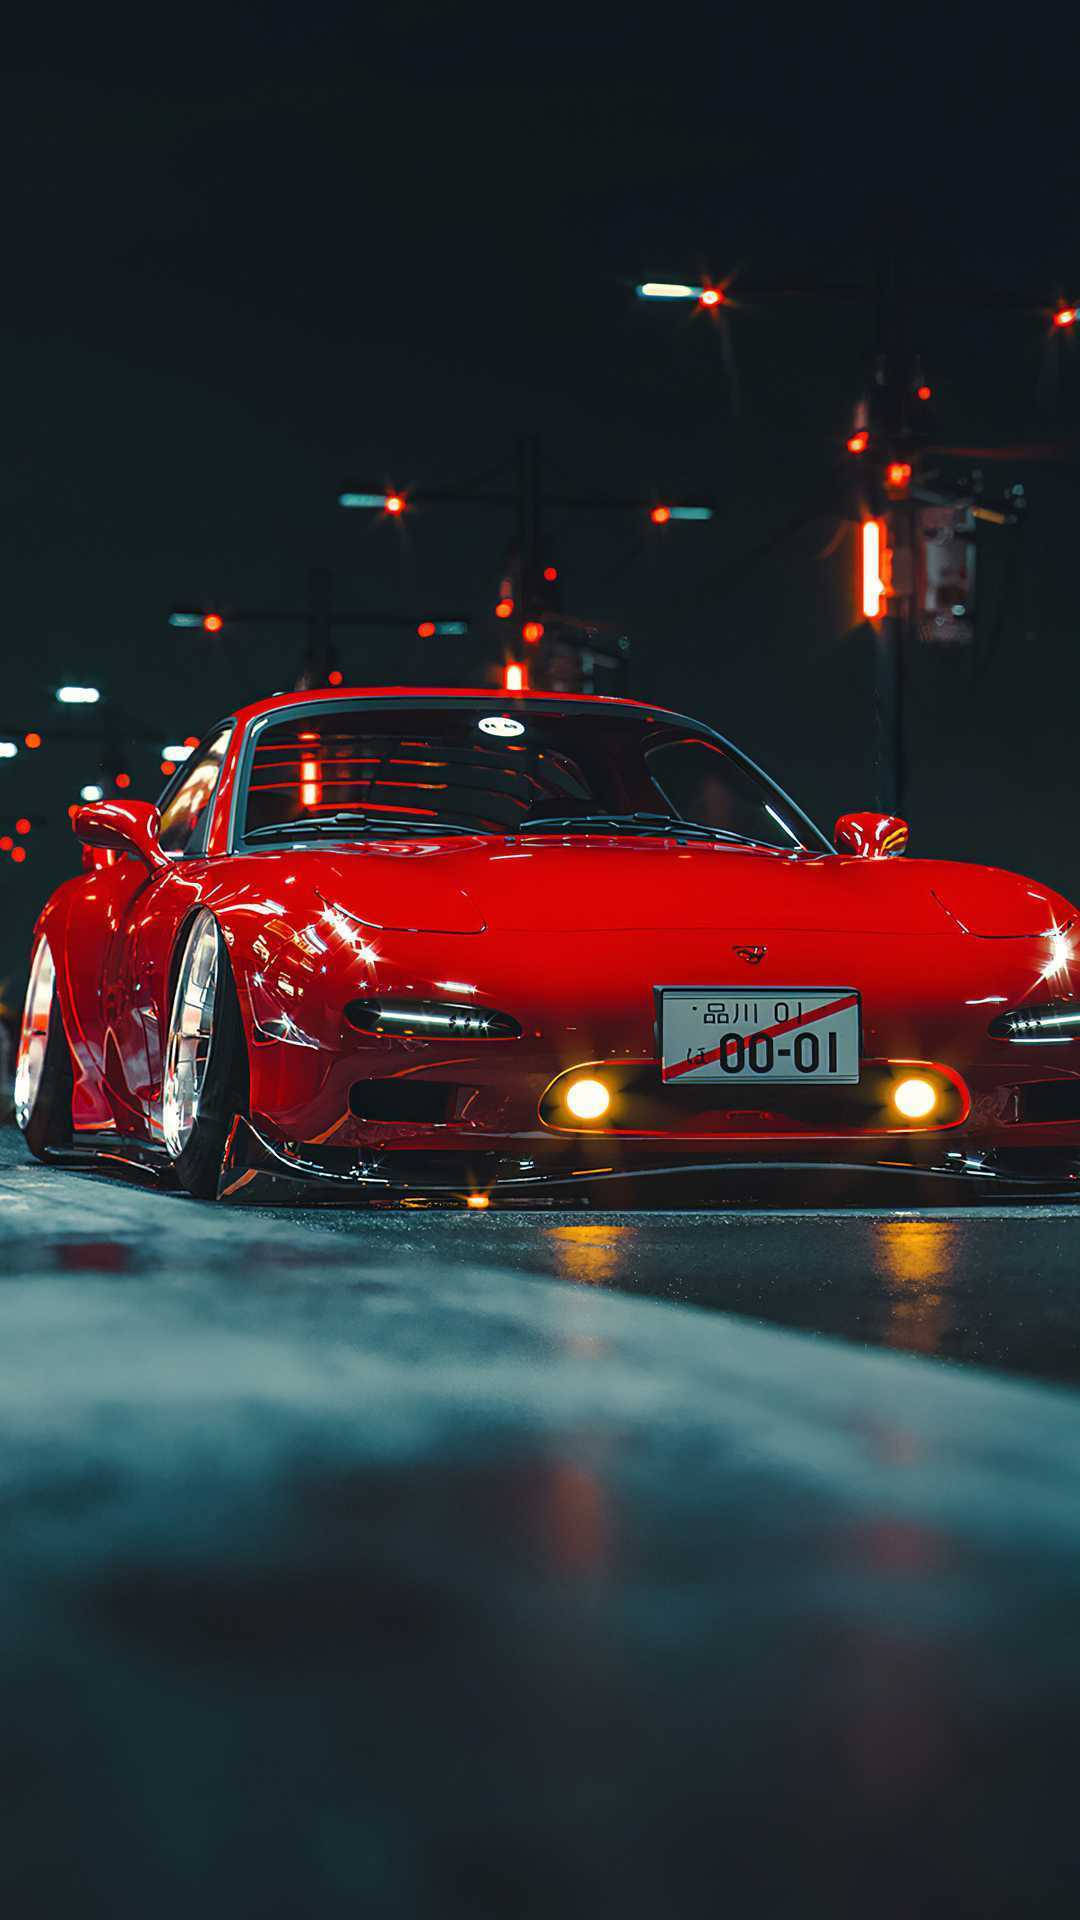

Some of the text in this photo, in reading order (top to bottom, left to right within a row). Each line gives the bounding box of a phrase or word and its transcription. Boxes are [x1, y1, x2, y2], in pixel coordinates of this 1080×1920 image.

[704, 1002, 802, 1024] 品川 01
[719, 1032, 837, 1074] 00-01
